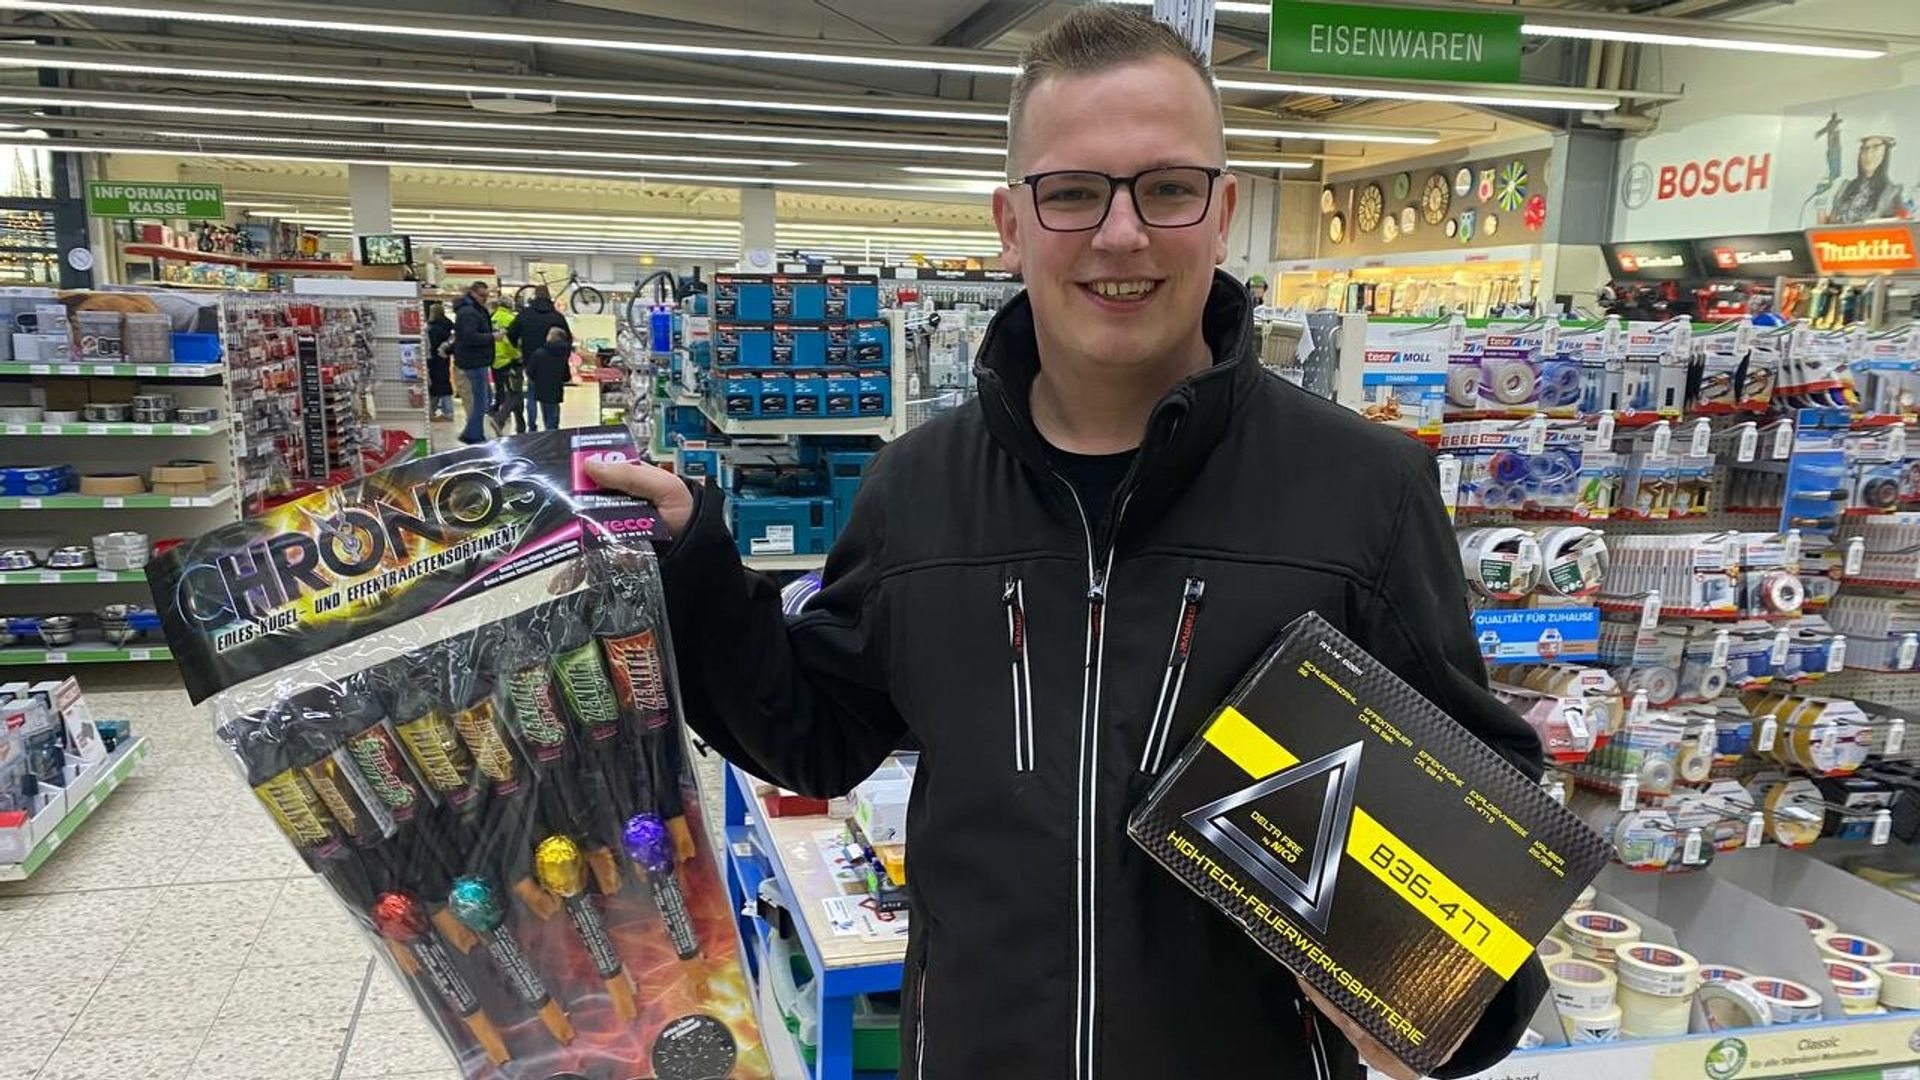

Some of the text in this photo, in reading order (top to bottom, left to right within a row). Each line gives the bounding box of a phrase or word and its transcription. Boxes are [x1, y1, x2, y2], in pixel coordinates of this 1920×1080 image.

[1310, 24, 1483, 62] EISENWAREN
[1657, 152, 1771, 200] BOSCH
[94, 186, 217, 201] INFORMATION
[128, 201, 187, 214] KASSE
[1489, 337, 1513, 346] tesa
[1367, 352, 1431, 362] tesa MOLL
[586, 518, 653, 536] weco
[315, 594, 341, 614] UND
[347, 524, 518, 603] EFFEKTRAKETENSORTIMENT
[1476, 612, 1594, 625] QUALITÄT FÜR ZUHAUSE
[1250, 810, 1304, 857] DELTA FIRE
[1270, 841, 1297, 864] NICO
[1534, 840, 1566, 866] KALIBER
[1167, 830, 1426, 1046] HIGHTECH-FEUERWERKSBATTERIE
[1797, 1036, 1841, 1051] Classic
